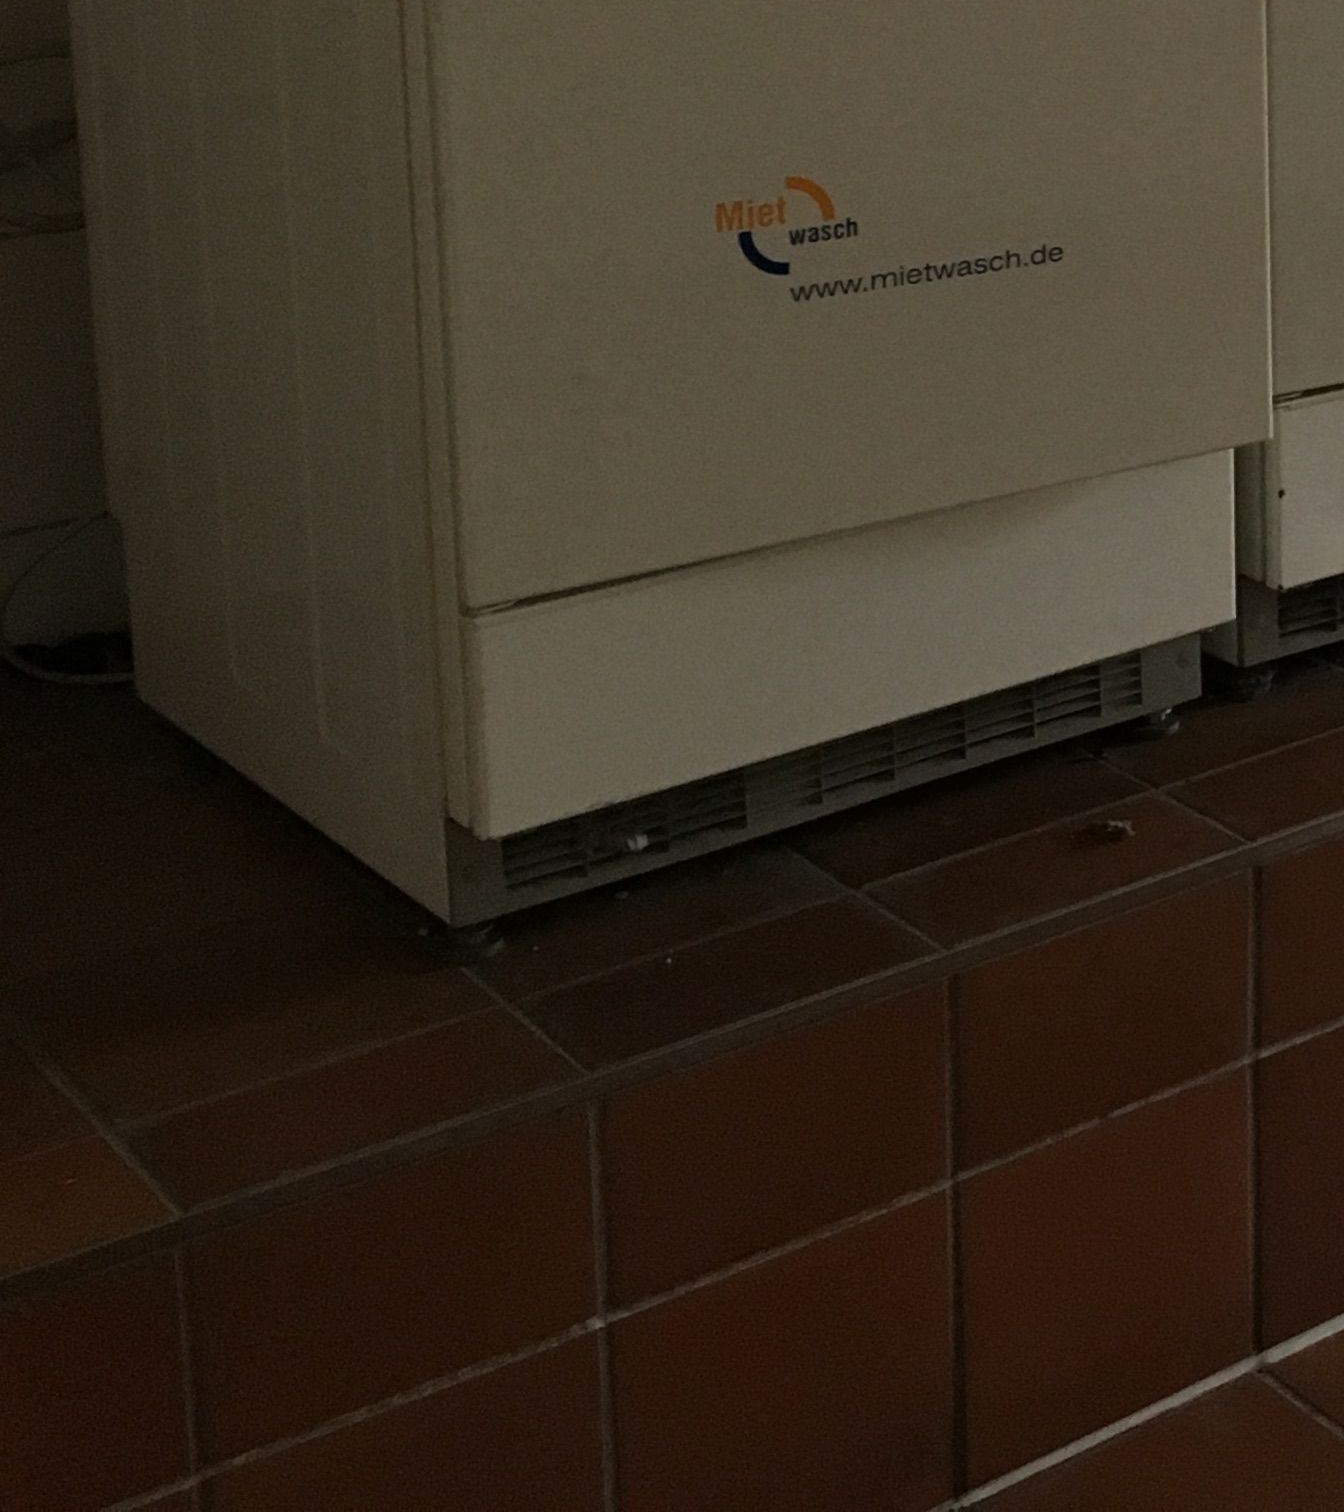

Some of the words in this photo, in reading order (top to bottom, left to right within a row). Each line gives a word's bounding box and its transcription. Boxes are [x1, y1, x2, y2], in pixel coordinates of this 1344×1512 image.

[714, 195, 788, 232] Miet
[788, 217, 859, 246] wasch
[789, 244, 1064, 303] www.mietwasch.de
